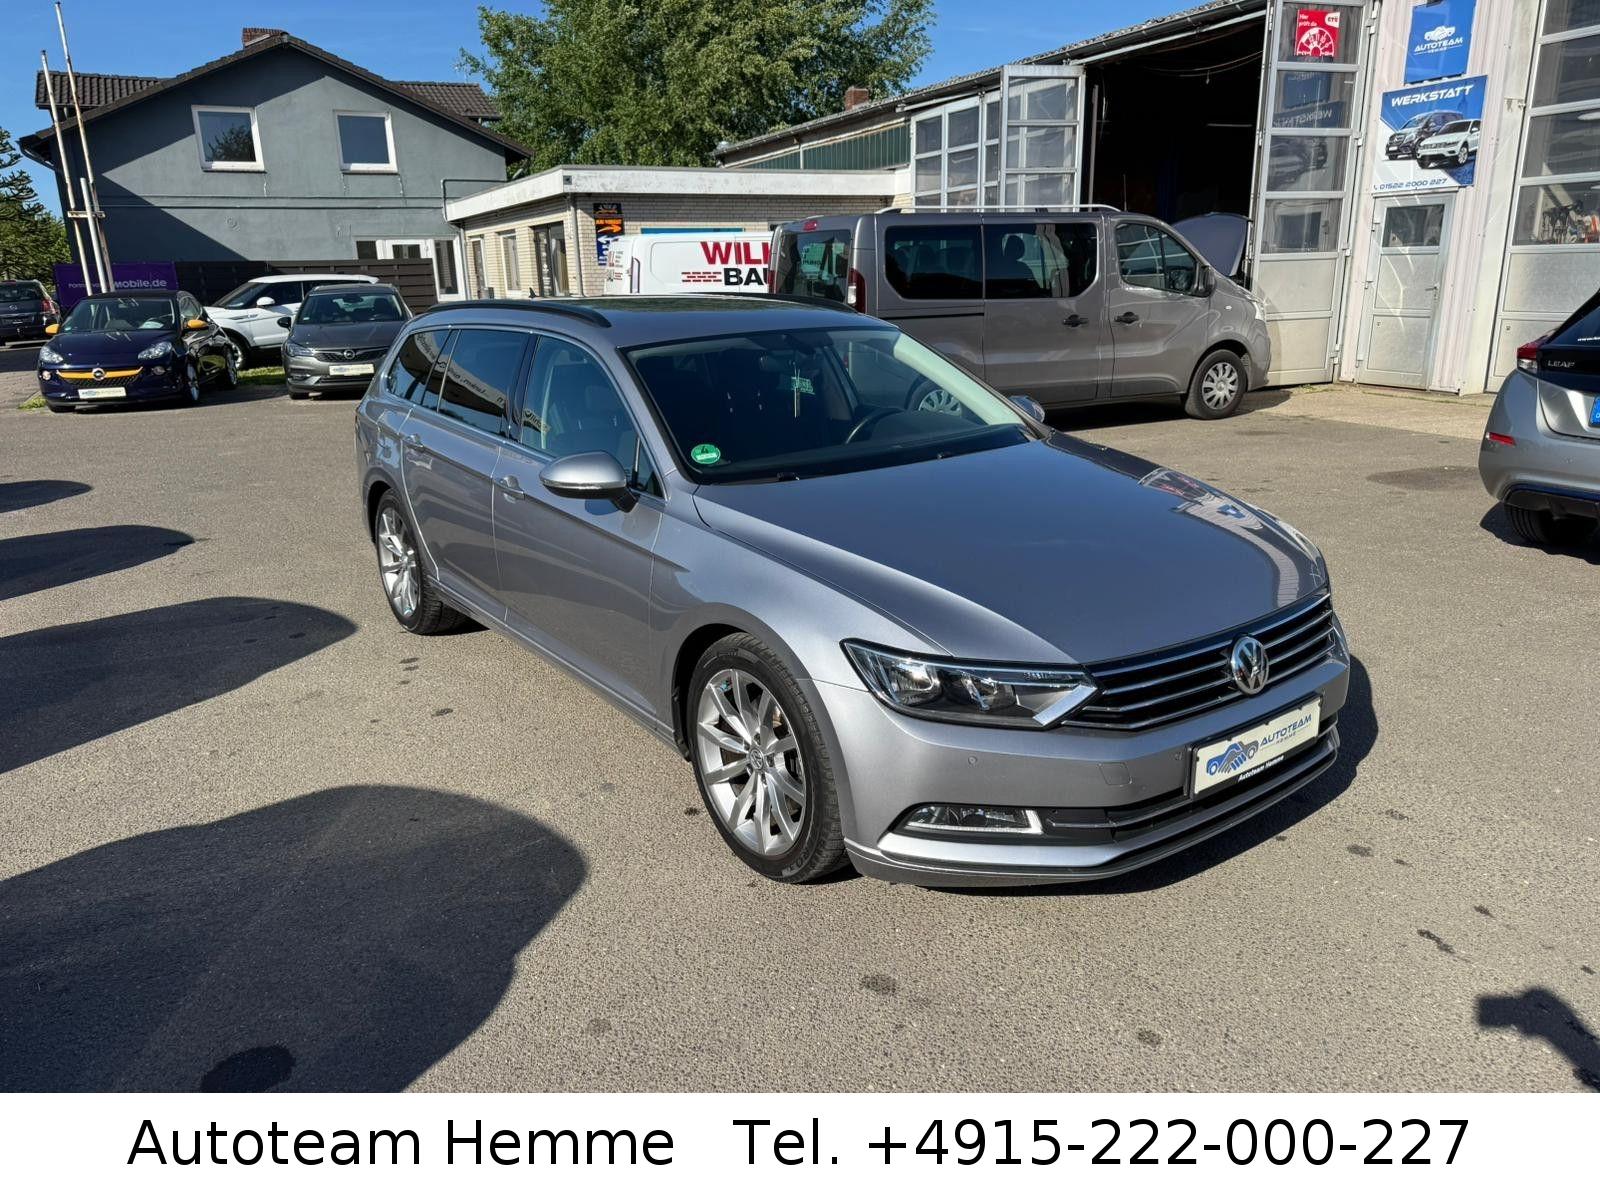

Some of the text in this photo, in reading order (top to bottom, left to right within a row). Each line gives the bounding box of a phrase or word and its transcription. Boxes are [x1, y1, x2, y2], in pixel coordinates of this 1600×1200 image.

[1414, 36, 1463, 52] AUTOTEAM
[1391, 84, 1474, 107] WERKSTATT
[1405, 179, 1428, 188] 2000
[1429, 178, 1448, 186] 227
[114, 279, 167, 288] mobile.de
[1547, 360, 1575, 368] LEAF
[1260, 714, 1312, 746] AUTOTEAM
[1238, 765, 1265, 783] Autoteam
